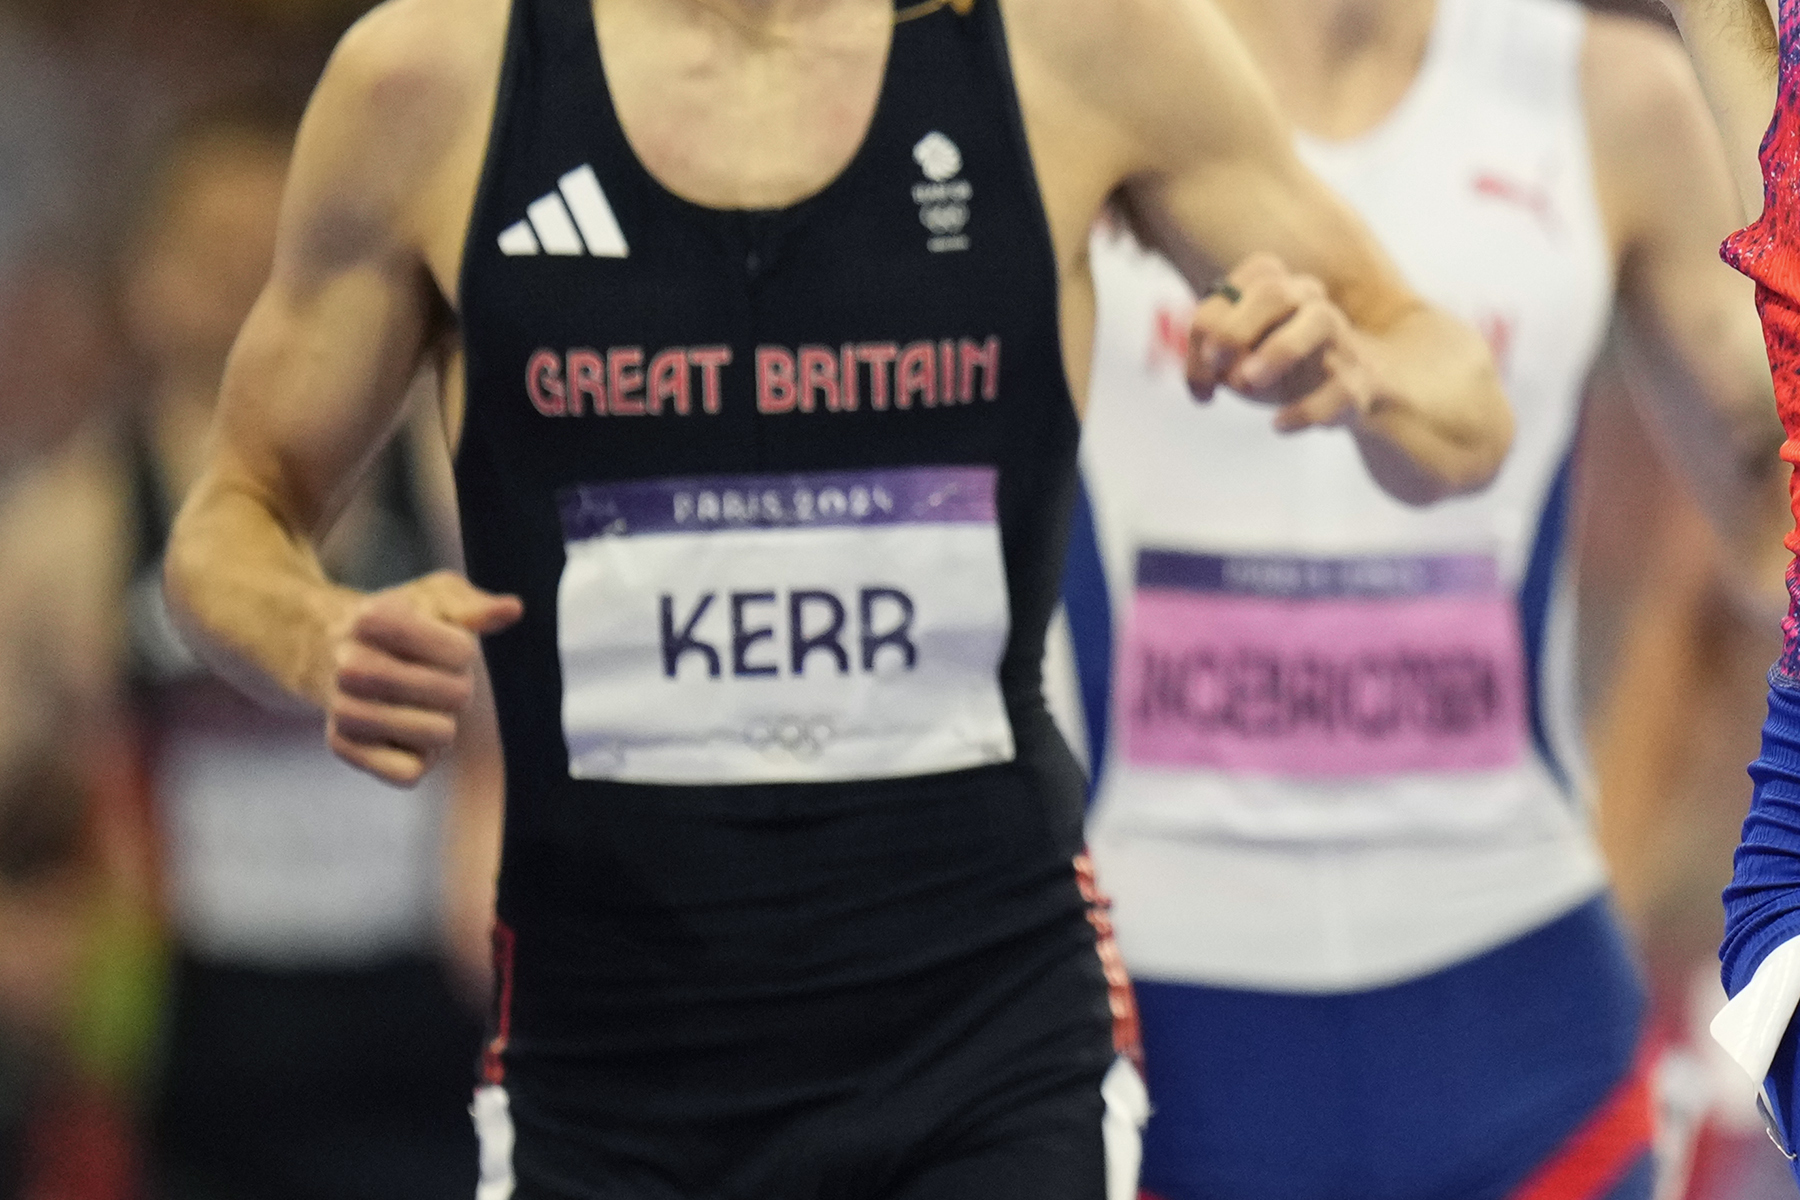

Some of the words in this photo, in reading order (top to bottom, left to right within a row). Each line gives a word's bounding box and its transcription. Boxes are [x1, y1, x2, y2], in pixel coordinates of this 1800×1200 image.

[527, 344, 732, 417] GREAT
[756, 336, 1001, 414] BRITAIN
[658, 587, 917, 681] KERR
